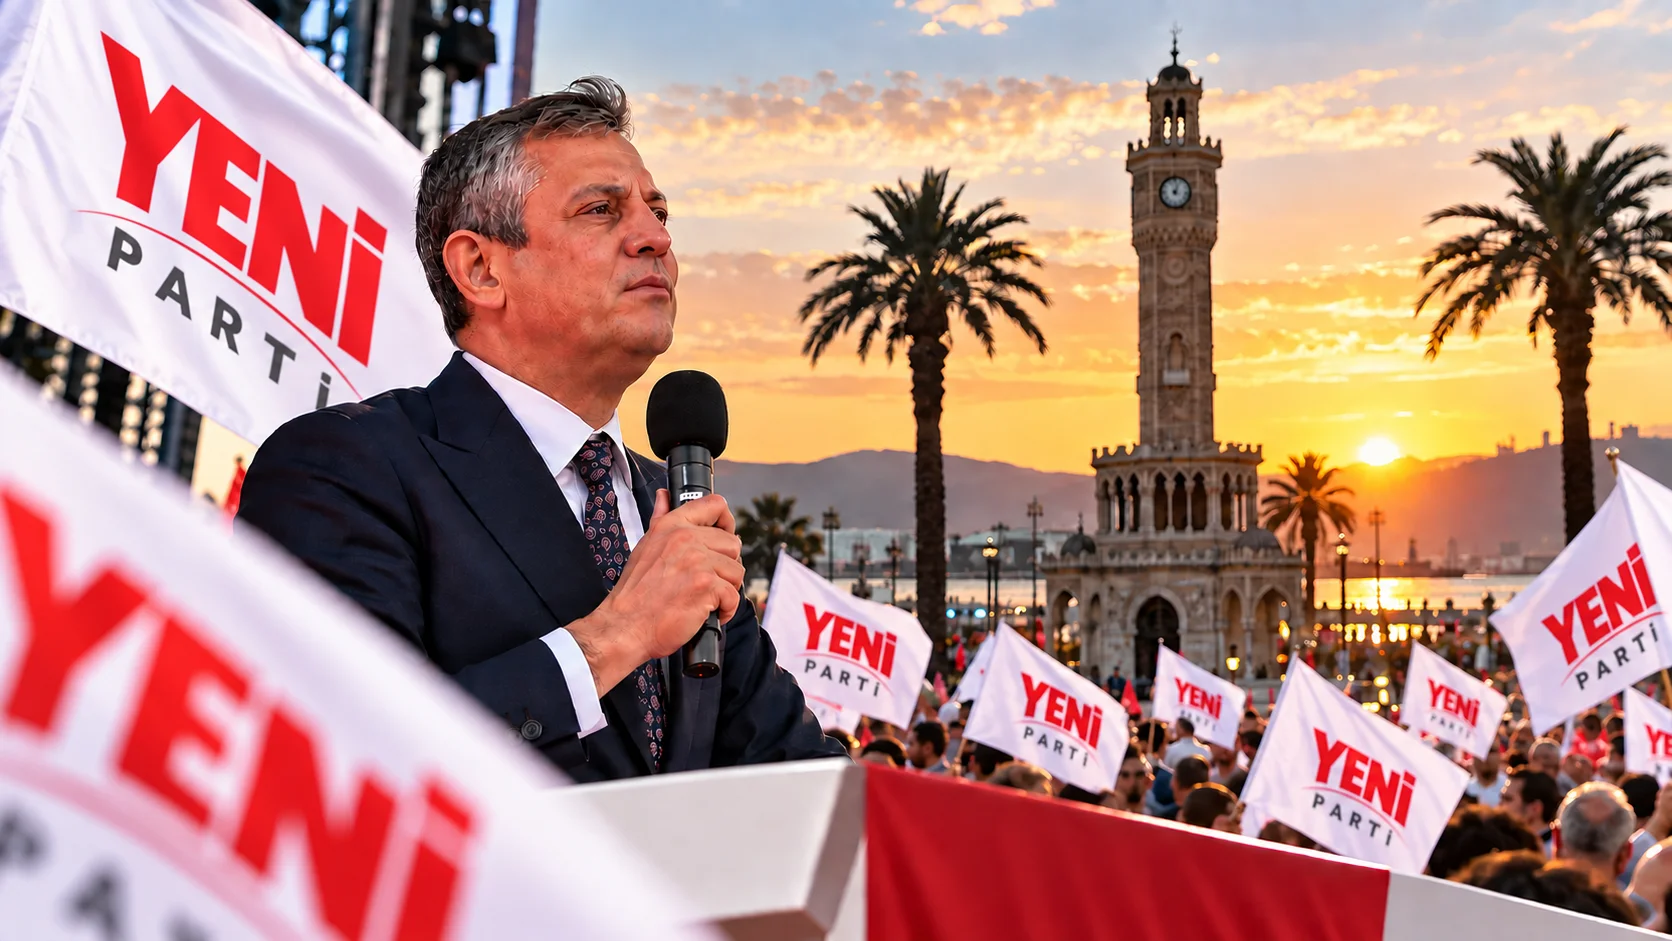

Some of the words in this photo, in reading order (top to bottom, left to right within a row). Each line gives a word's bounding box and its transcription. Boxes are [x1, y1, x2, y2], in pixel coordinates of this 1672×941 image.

[101, 31, 388, 367] YENİ
[107, 226, 331, 409] PARTİ
[1541, 542, 1657, 666] YENİ
[803, 603, 897, 679] YENİ
[1575, 622, 1659, 690] PARTİ
[804, 658, 880, 697] PARTİ
[1022, 671, 1103, 750] YENİ
[1174, 676, 1222, 720] YENİ
[1427, 677, 1481, 728] YENİ
[1023, 725, 1088, 768] PARTİ
[1313, 728, 1417, 828] YENİ
[1312, 793, 1394, 847] PARTİ
